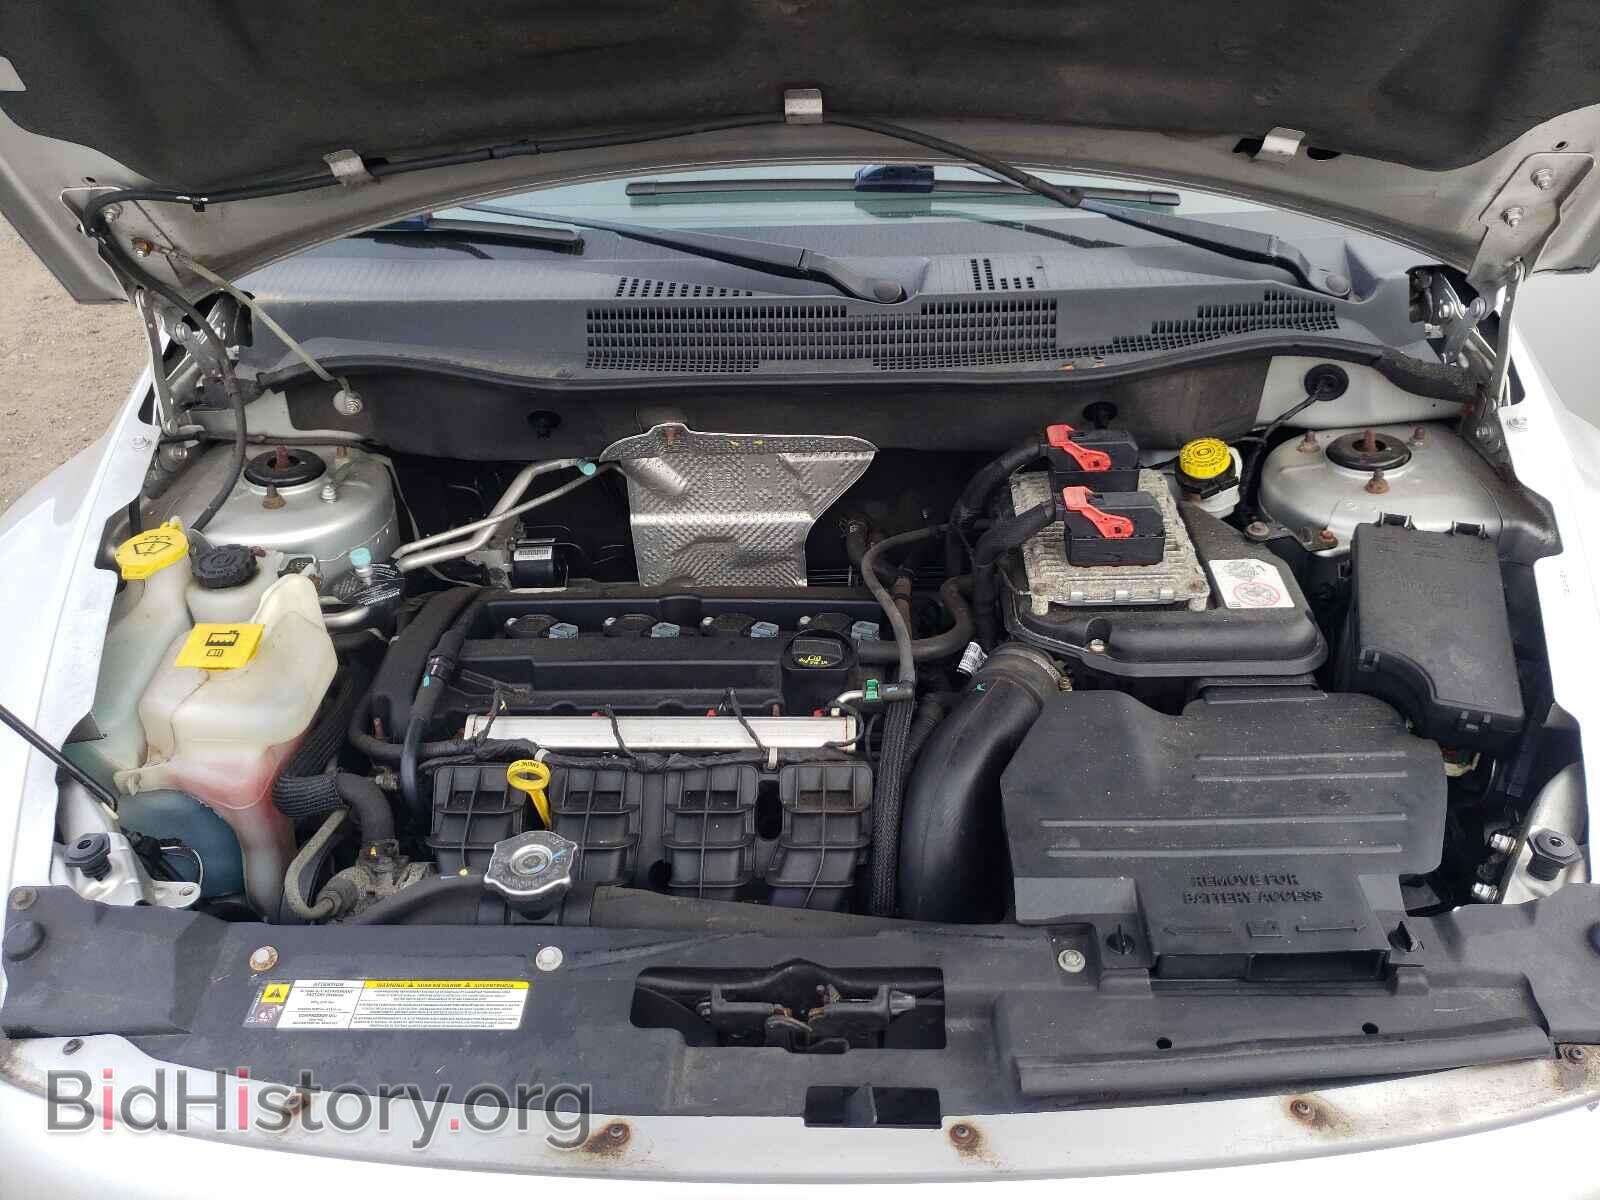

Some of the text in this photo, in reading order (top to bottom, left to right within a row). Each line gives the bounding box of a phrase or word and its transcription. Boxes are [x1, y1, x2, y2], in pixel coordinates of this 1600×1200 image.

[1192, 872, 1299, 887] REMOVE FOR
[1183, 889, 1323, 904] BATTERY ACCESS
